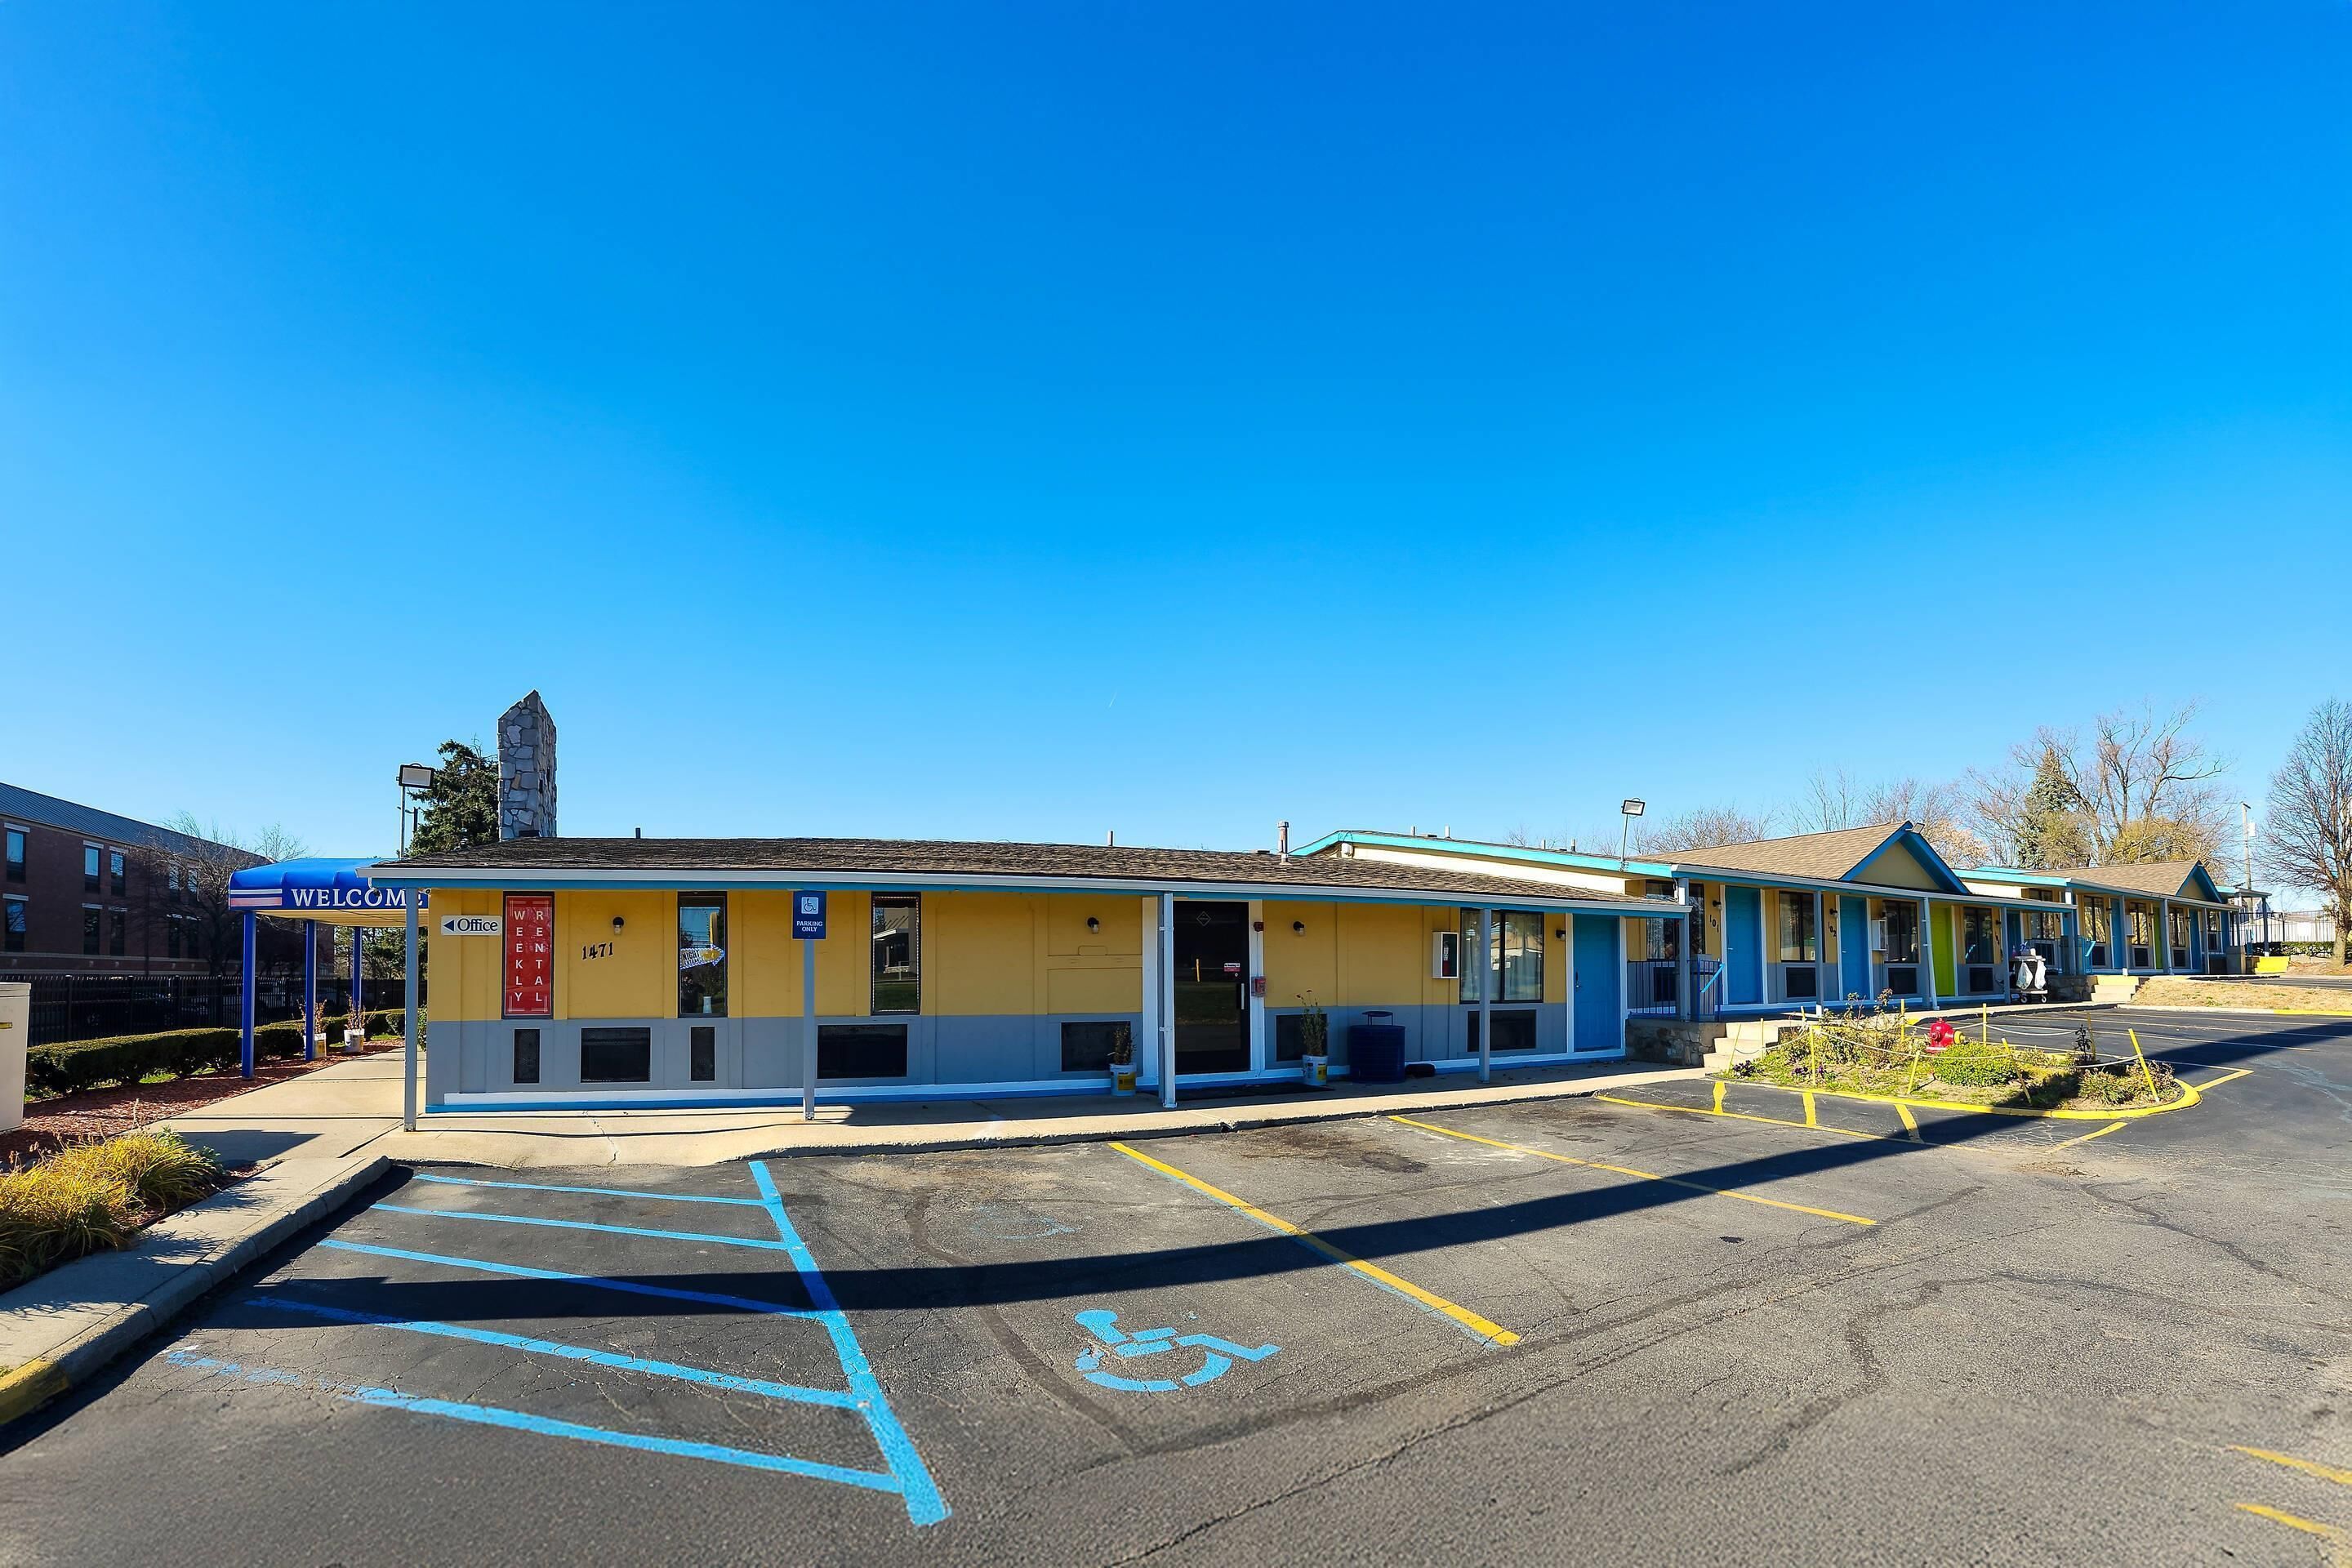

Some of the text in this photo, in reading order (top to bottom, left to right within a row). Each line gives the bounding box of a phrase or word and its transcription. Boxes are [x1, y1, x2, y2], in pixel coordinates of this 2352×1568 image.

[291, 888, 423, 907] WELCOM
[457, 918, 498, 932] Office
[1709, 914, 1720, 933] 101
[513, 911, 525, 1002] WEEKLY
[534, 911, 544, 1002] RENTAL
[581, 942, 614, 960] 1471
[682, 949, 700, 960] NIGHT
